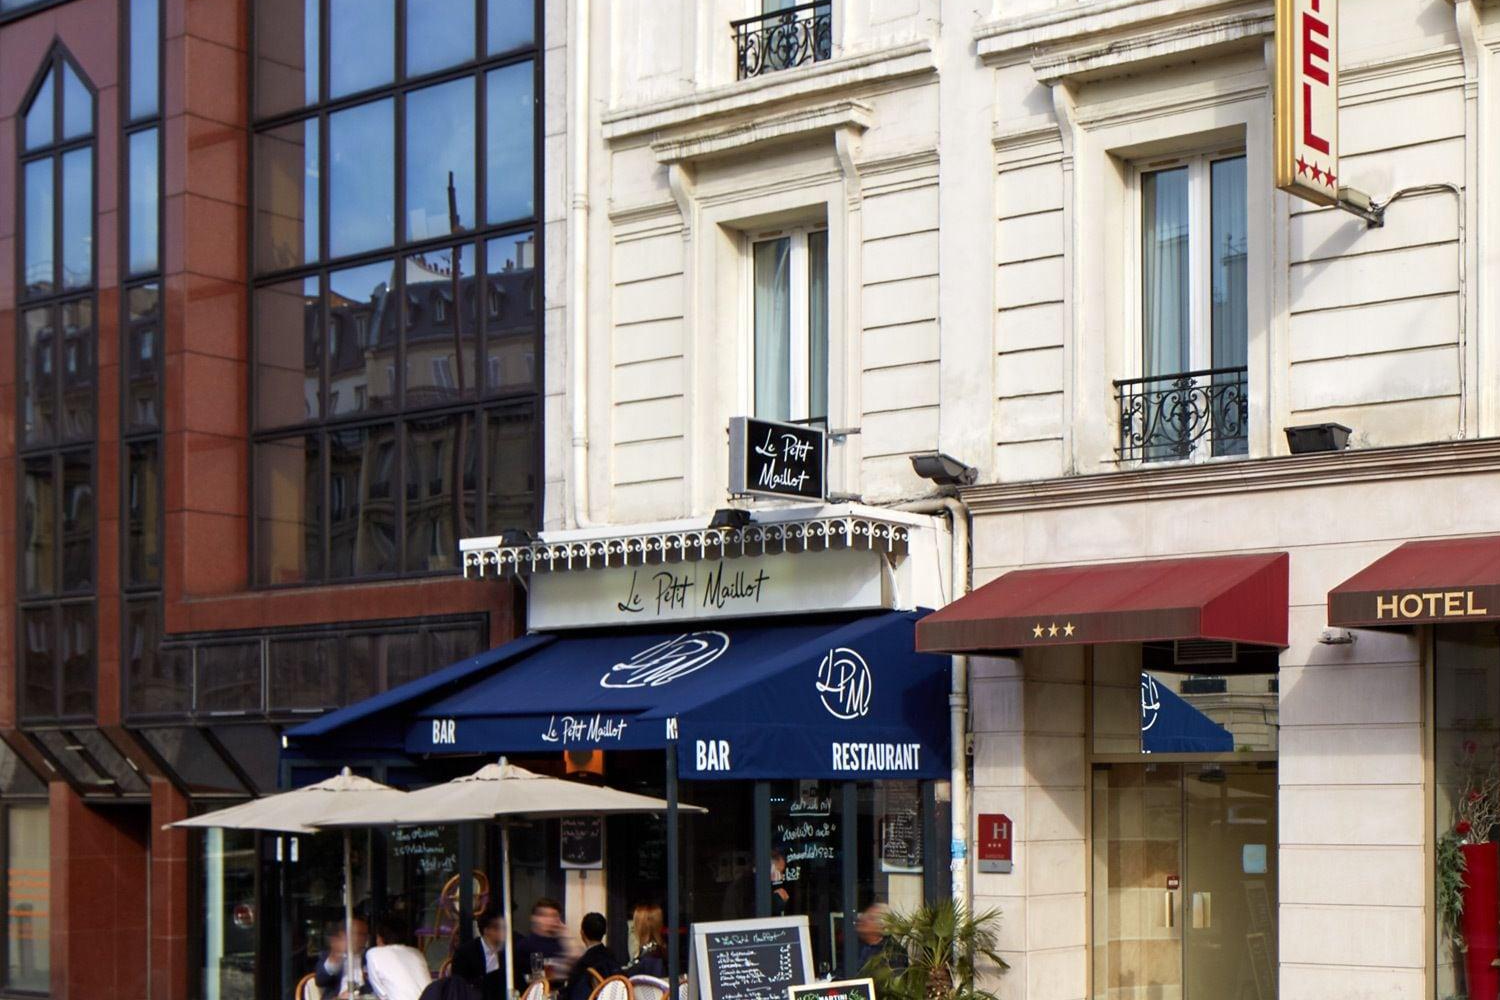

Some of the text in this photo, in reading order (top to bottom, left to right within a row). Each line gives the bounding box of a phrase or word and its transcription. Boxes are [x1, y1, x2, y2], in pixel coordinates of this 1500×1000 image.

[755, 428, 814, 462] Le Petit
[758, 458, 810, 491] Maillot
[617, 560, 770, 615] Le Petit Maillot
[1376, 591, 1487, 619] HOTEL
[432, 719, 456, 744] BAR
[541, 713, 628, 744] Le Petit Maillot
[696, 740, 731, 771] BAR
[832, 742, 921, 771] RESTAURANT
[993, 822, 1008, 840] H
